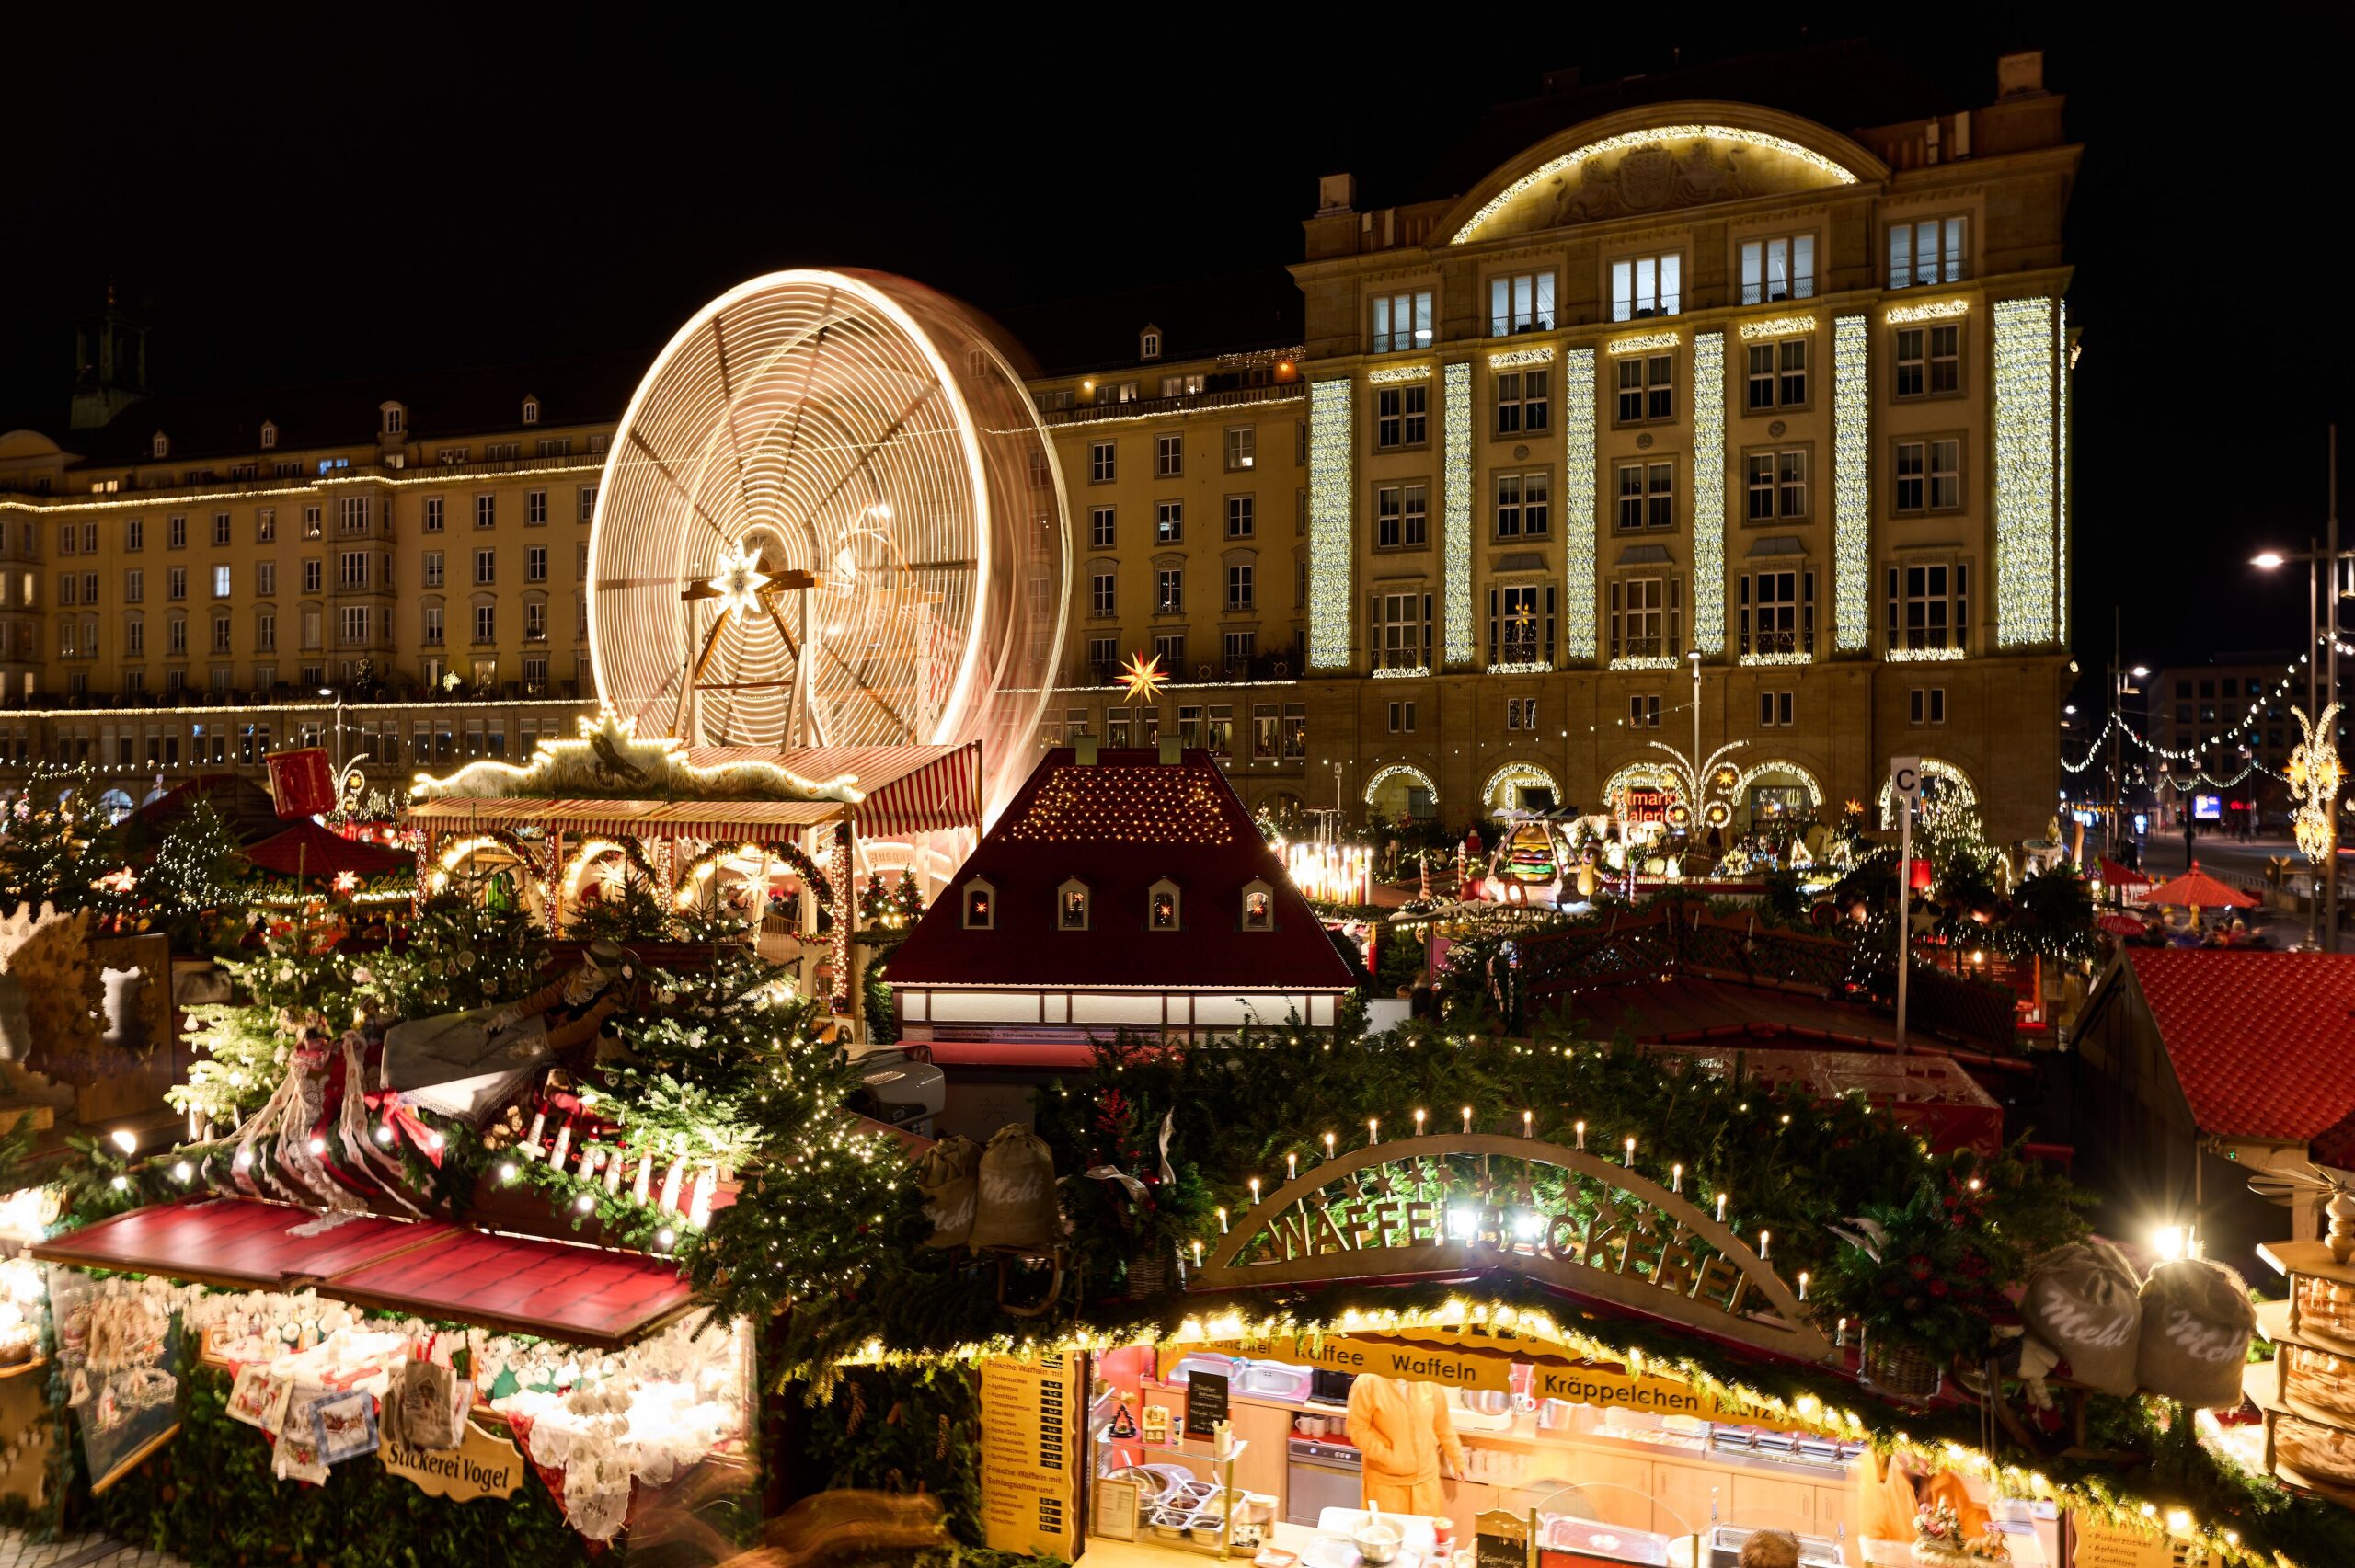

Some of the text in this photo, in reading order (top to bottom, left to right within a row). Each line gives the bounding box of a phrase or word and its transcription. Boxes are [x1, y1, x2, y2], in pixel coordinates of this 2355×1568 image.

[1896, 769, 1915, 792] C
[868, 852, 913, 864] Ausgan
[982, 1172, 1045, 1204] Mehl
[2040, 1291, 2134, 1348] Mehl
[986, 1359, 1017, 1371] Frische
[1018, 1365, 1048, 1375] Waffeln
[1391, 1353, 1477, 1382] Waffeln
[1545, 1374, 1700, 1411] Kräppelchen
[388, 1442, 510, 1493] Stickerei Vogel
[986, 1463, 1016, 1476] Frische
[1017, 1469, 1047, 1481] Waffeln
[986, 1476, 1053, 1494] Schlagsahne und
[2095, 1533, 2152, 1549] Puderzucker
[2094, 1545, 2138, 1557] Apfelmus
[2095, 1555, 2137, 1568] Konfitüre
